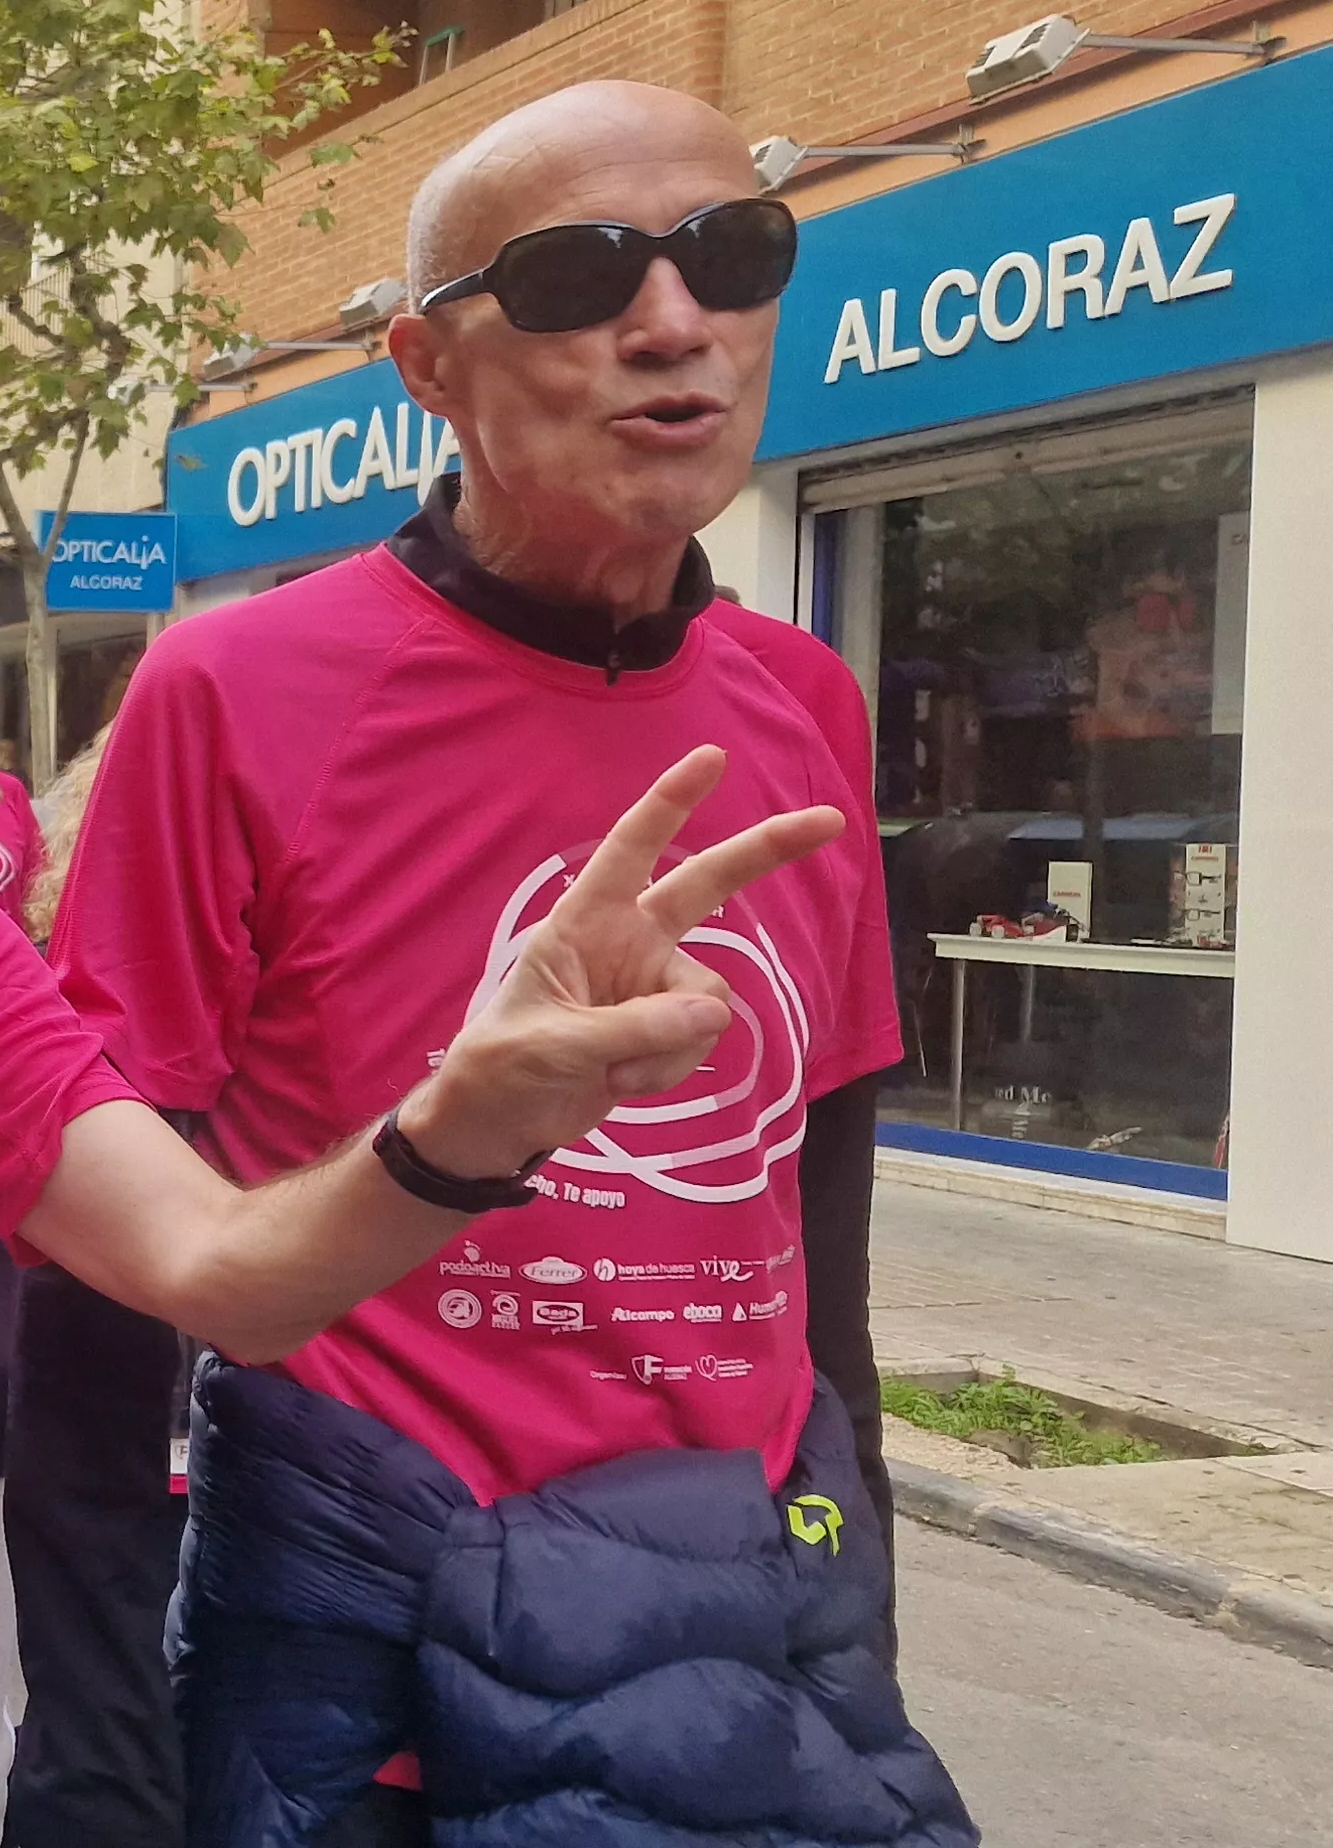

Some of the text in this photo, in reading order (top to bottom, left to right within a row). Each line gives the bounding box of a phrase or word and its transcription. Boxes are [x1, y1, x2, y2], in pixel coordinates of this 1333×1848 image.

[823, 193, 1236, 385] ALCORAZ
[69, 574, 144, 591] ALCORAZ
[564, 1182, 581, 1202] Te
[582, 1187, 626, 1210] apoyo
[440, 1260, 511, 1278] podoactiva
[531, 1266, 578, 1280] Ferrer
[618, 1262, 695, 1275] hoya de huesca
[700, 1255, 754, 1282] vive
